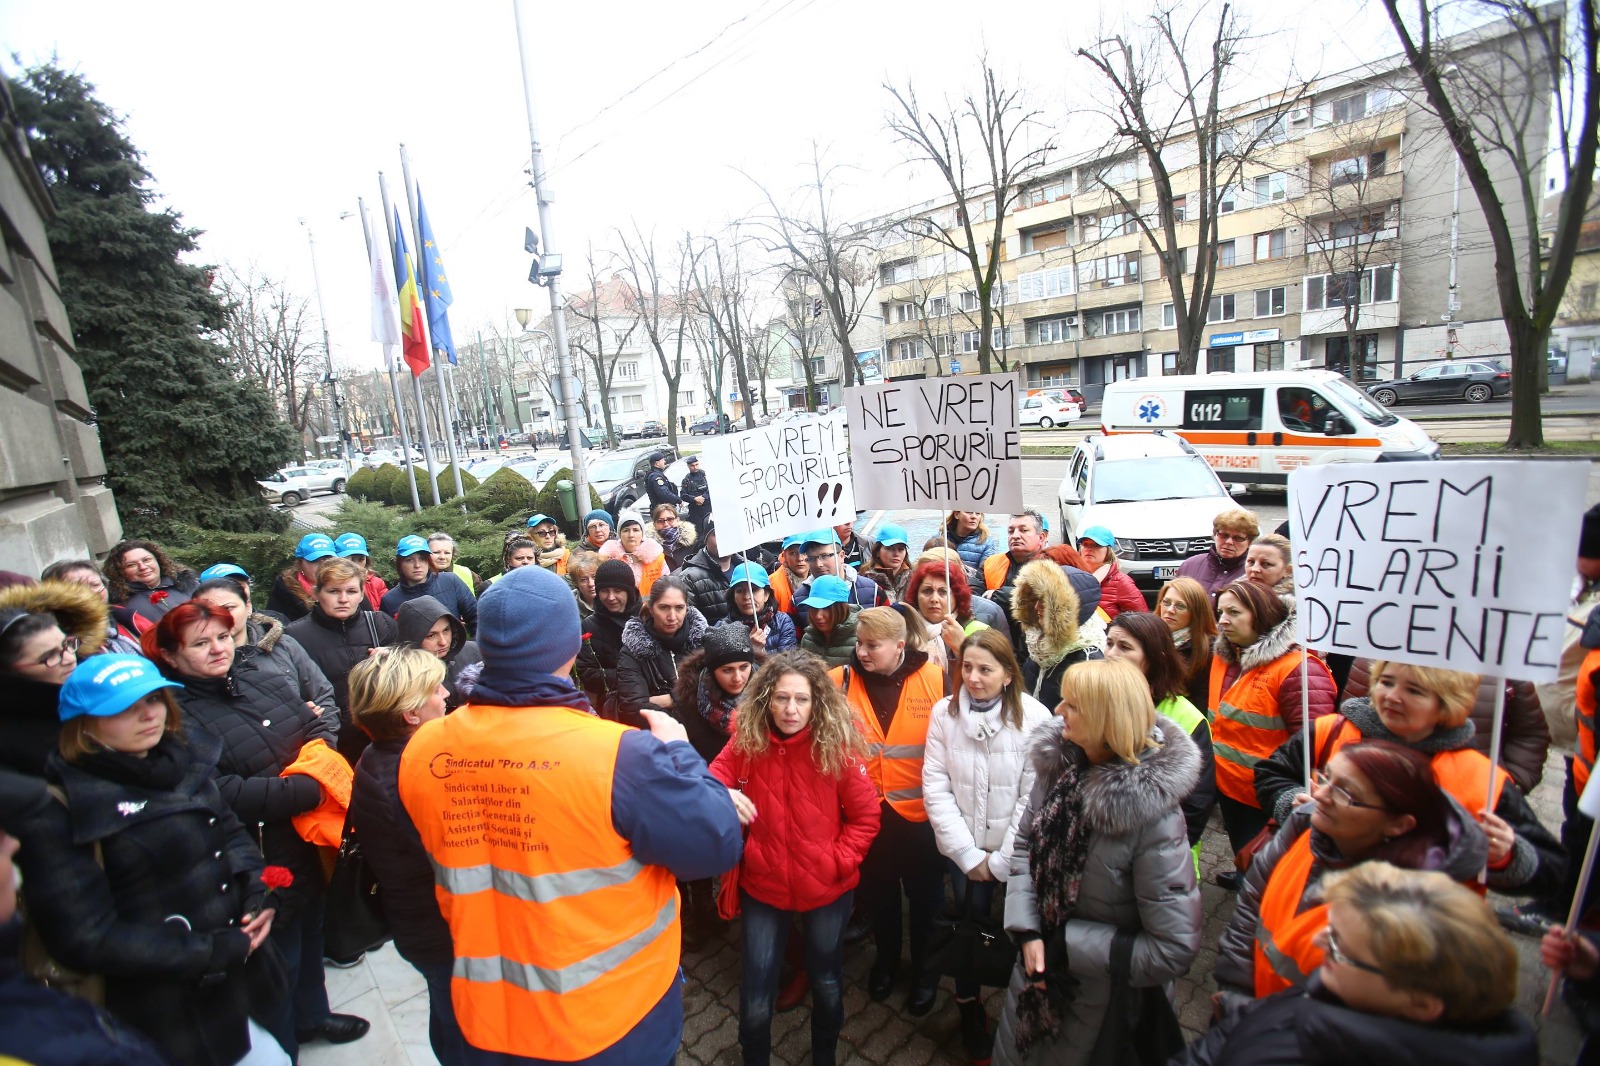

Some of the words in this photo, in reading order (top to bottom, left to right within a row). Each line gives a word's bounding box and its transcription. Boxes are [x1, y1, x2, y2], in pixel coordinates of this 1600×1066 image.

[861, 388, 907, 430] NE
[919, 379, 1016, 426] VREM
[730, 436, 756, 470] NE
[764, 420, 835, 459] VREM
[1296, 475, 1493, 545] VREM
[1304, 596, 1564, 669] DECENTE
[444, 758, 495, 769] Sindicatul
[443, 782, 488, 794] Sindicatul
[491, 783, 518, 795] Liber
[520, 785, 530, 796] al
[505, 799, 521, 809] din
[523, 814, 536, 825] de
